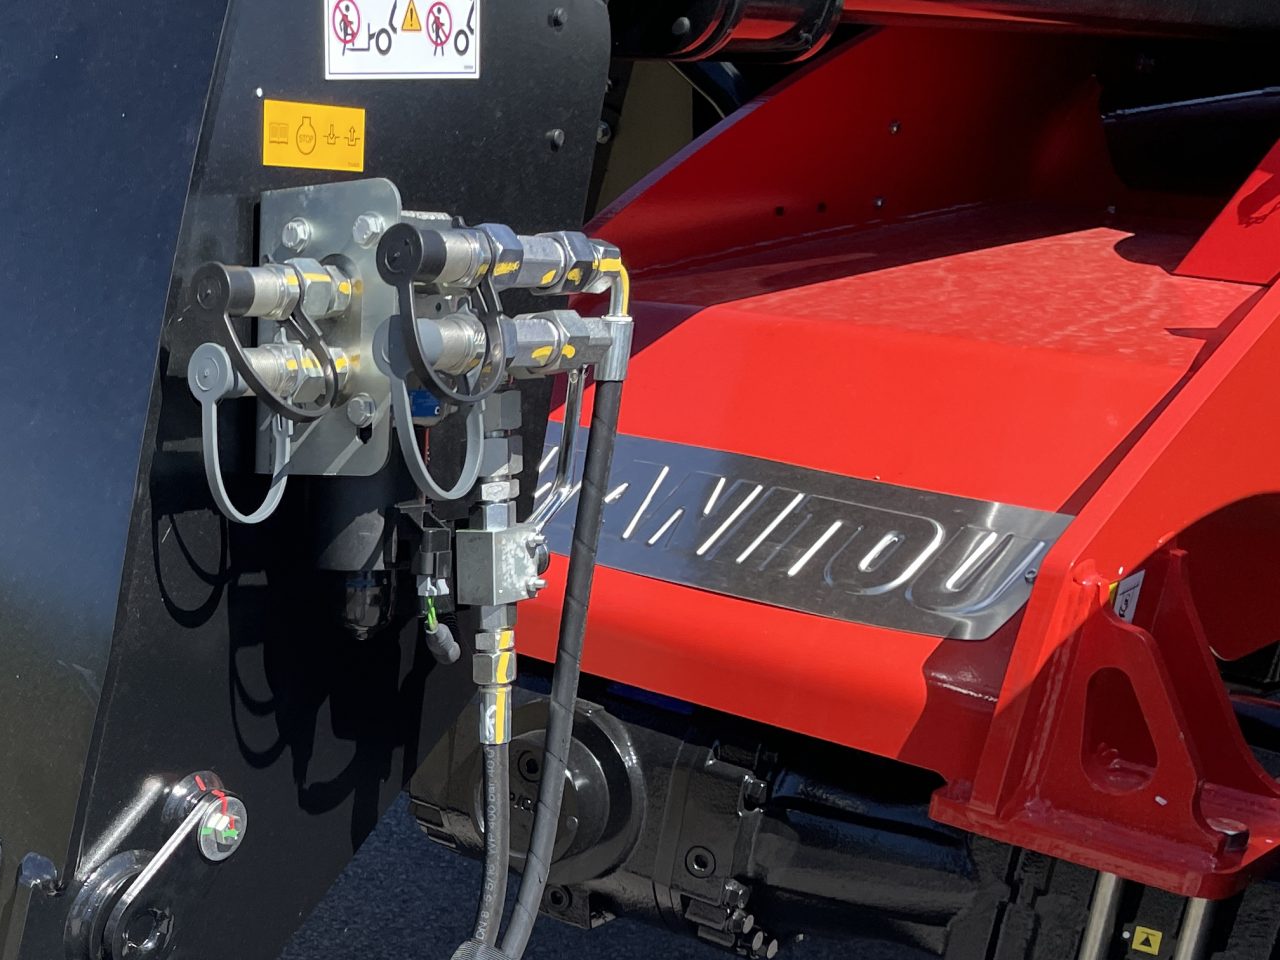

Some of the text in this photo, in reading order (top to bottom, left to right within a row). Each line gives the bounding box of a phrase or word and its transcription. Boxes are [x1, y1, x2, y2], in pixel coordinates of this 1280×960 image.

[298, 134, 313, 144] STOP
[475, 921, 488, 940] DN
[487, 832, 497, 856] WP
